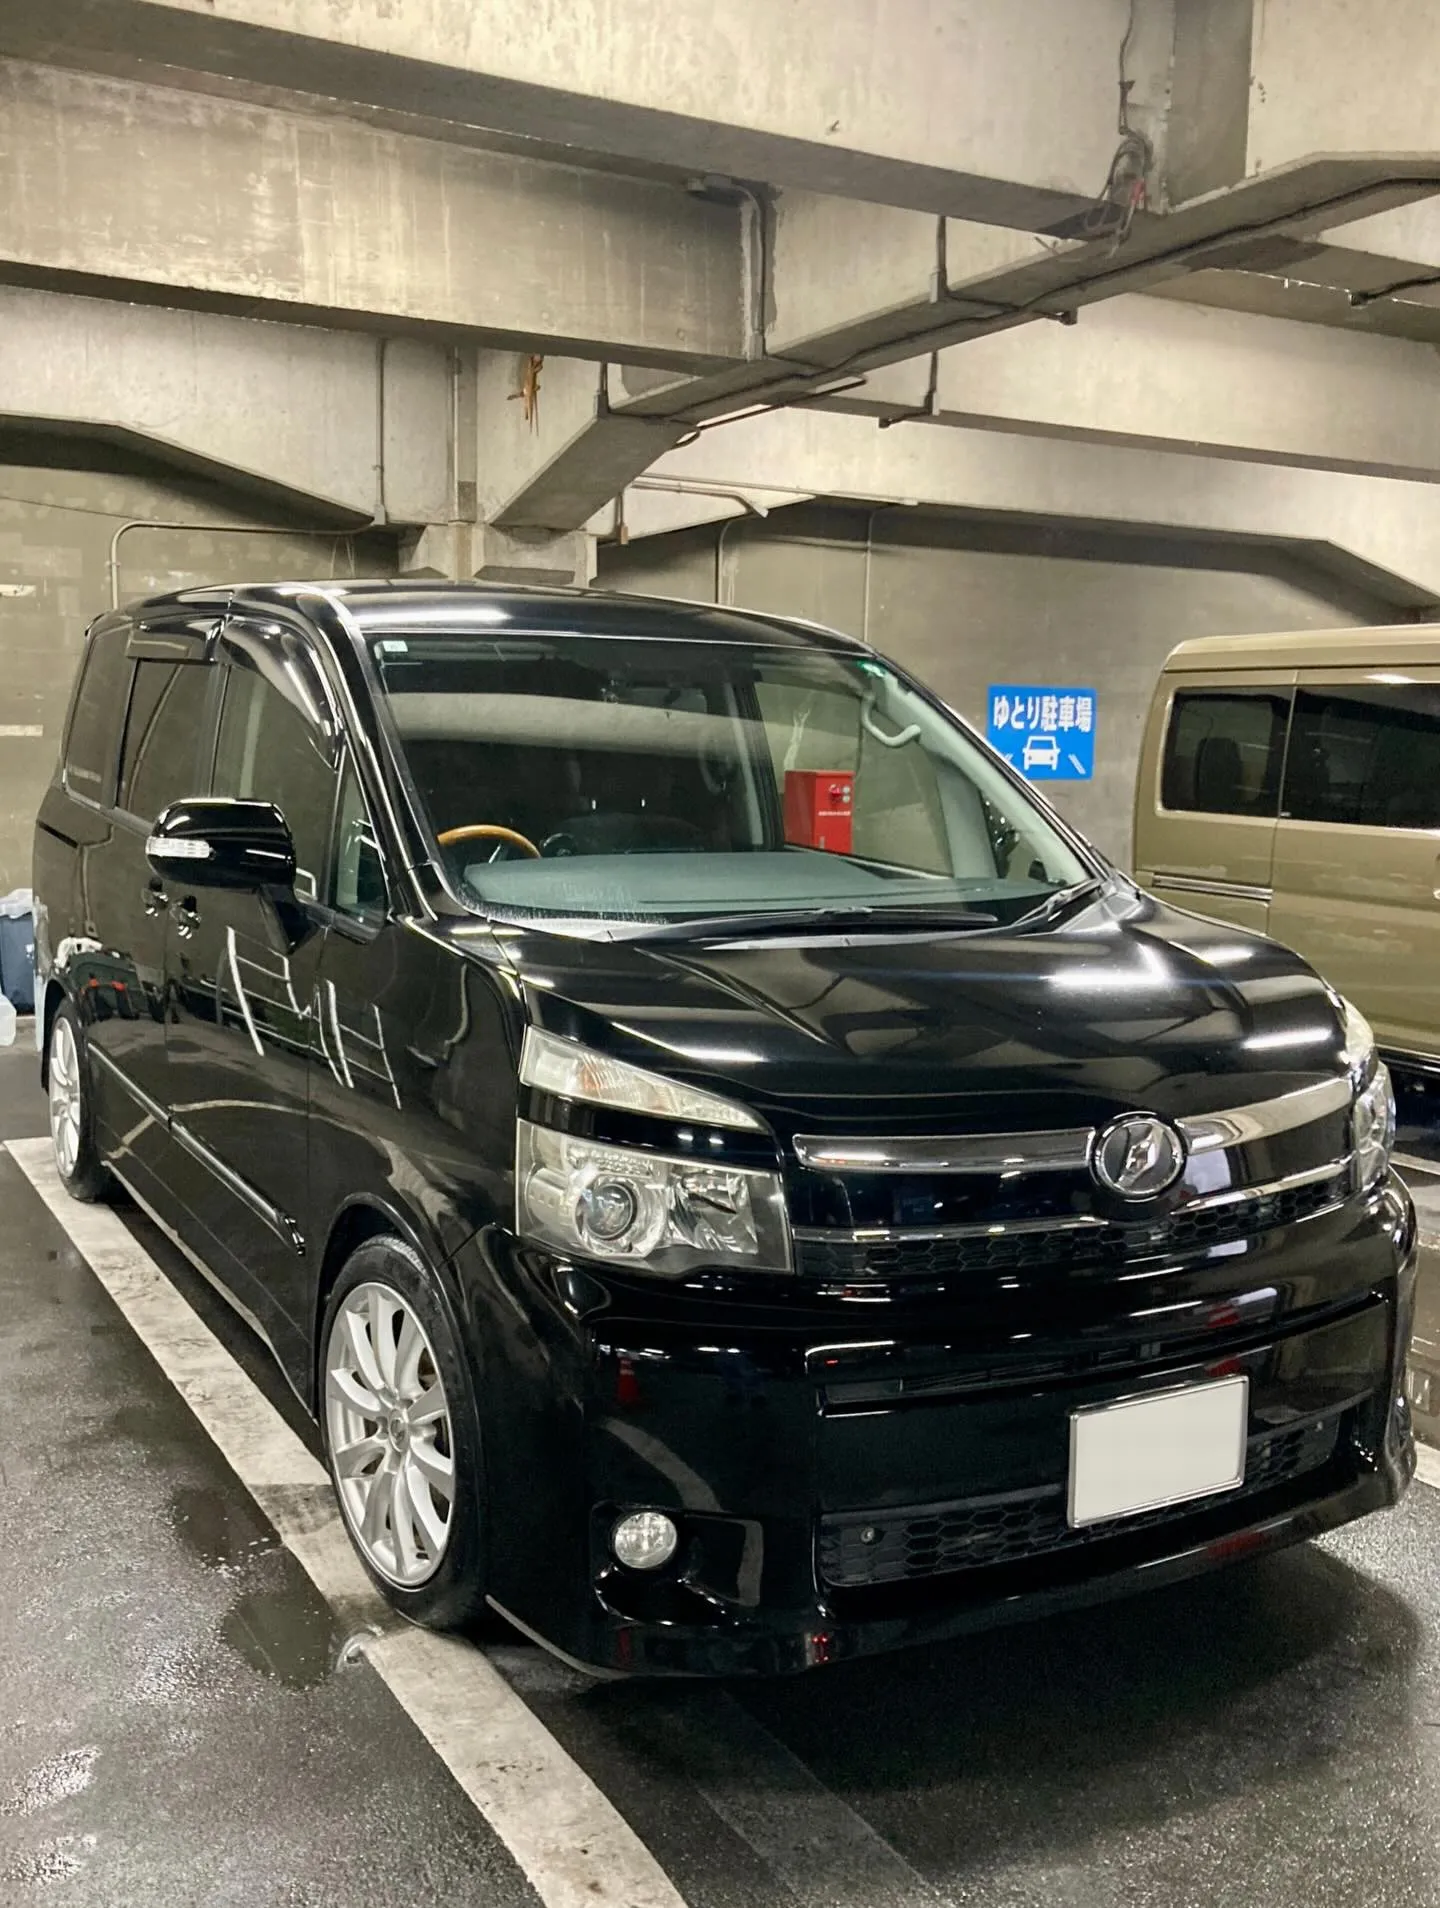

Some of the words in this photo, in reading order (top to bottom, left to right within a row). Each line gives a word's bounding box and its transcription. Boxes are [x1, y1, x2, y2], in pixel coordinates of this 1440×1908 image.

[993, 695, 1092, 732] ゆとり駐車場
